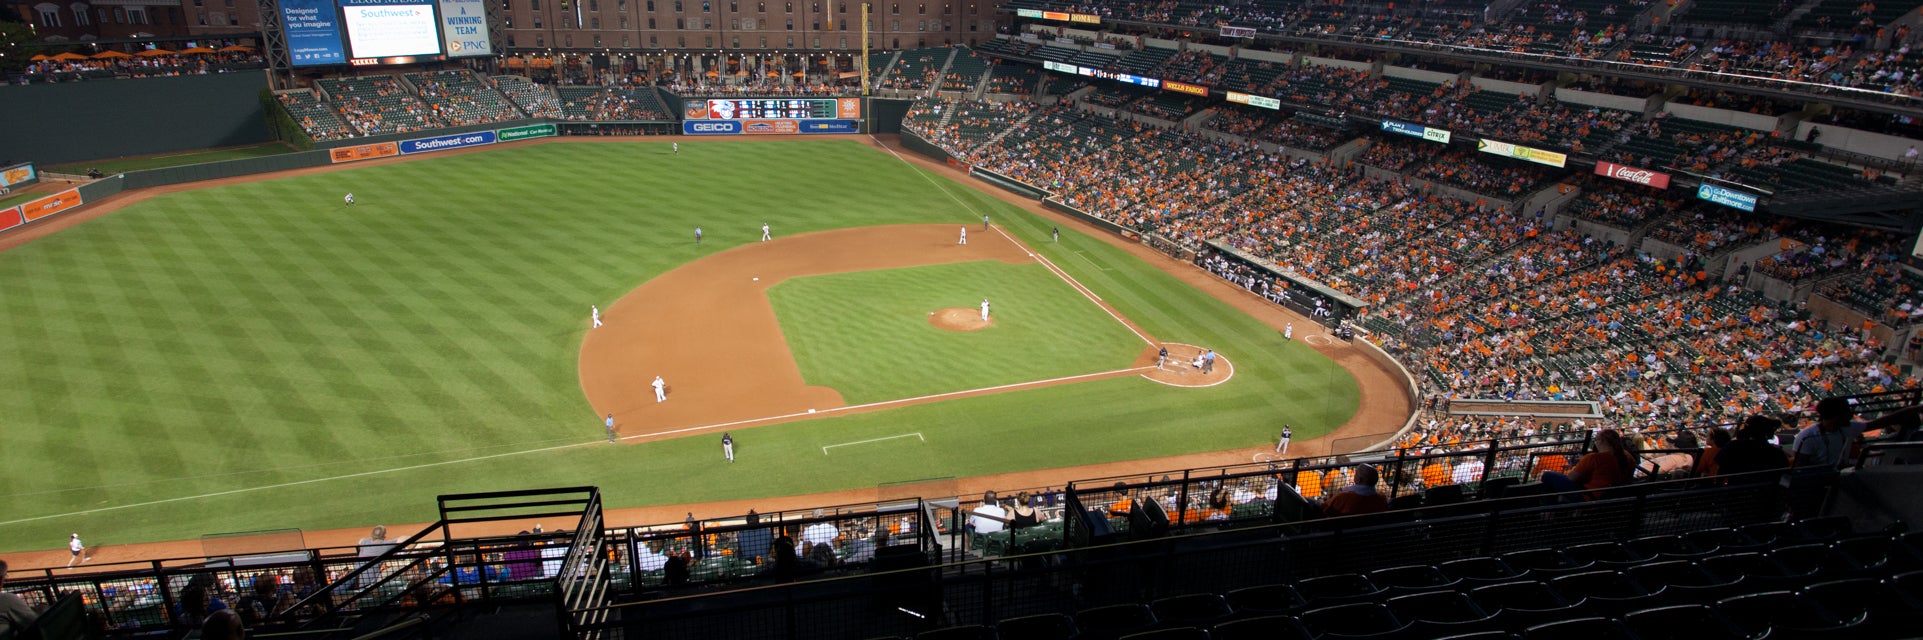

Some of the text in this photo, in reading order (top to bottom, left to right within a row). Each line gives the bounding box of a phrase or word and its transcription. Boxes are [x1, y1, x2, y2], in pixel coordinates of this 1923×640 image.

[285, 7, 318, 15] Designed
[361, 9, 414, 18] Southwest
[460, 7, 466, 15] A
[303, 21, 331, 29] imagine
[447, 16, 482, 25] WINNING
[455, 26, 478, 35] TEAM
[463, 40, 487, 50] PNC
[1166, 82, 1204, 94] WELLS FARGO
[693, 123, 733, 132] GEICO
